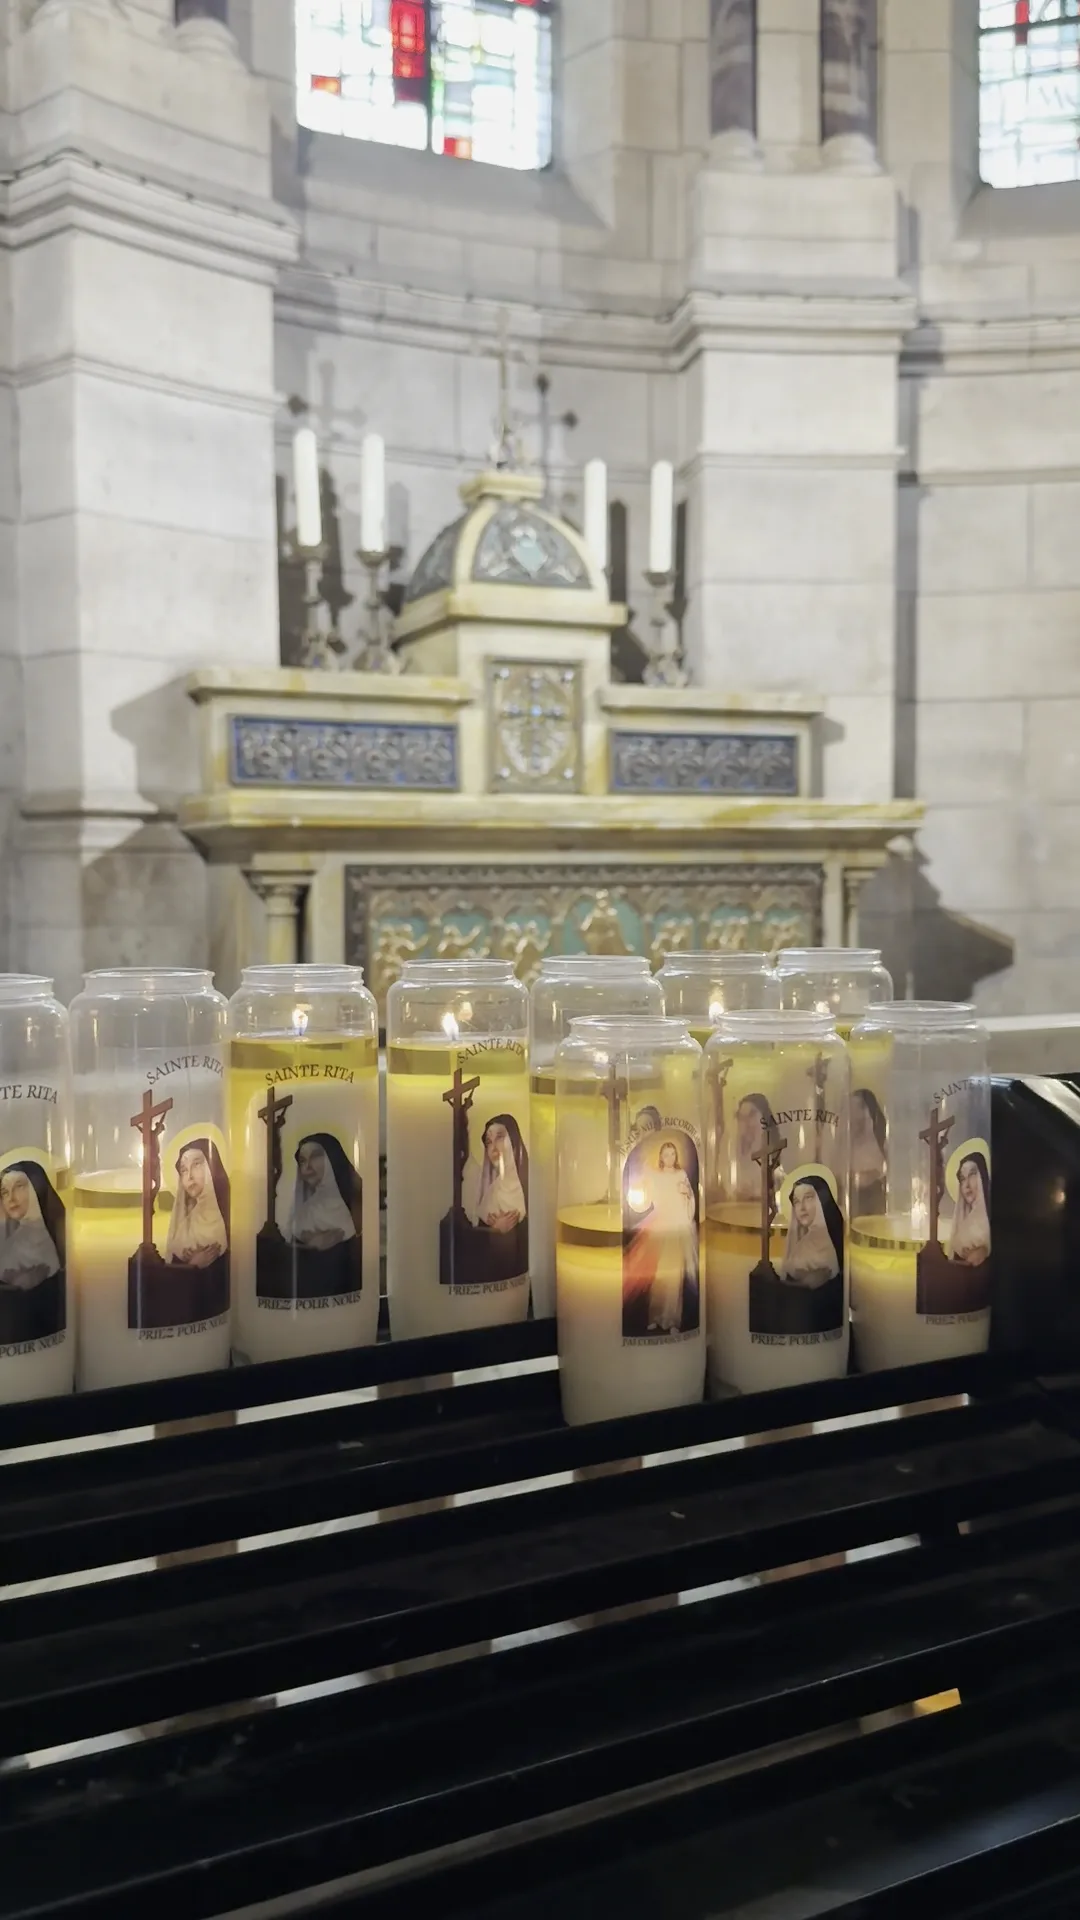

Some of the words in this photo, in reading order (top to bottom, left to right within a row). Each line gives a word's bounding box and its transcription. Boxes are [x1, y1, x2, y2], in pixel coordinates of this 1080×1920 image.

[457, 1038, 503, 1064] SAINTE
[146, 1055, 200, 1085] SAINTE
[203, 1055, 224, 1078] RITA
[265, 1063, 319, 1086] SAINTE
[324, 1064, 354, 1083] RITA
[27, 1084, 57, 1104] RITA
[760, 1109, 811, 1130] SAINTE
[815, 1109, 839, 1127] RITA
[258, 1298, 291, 1310] PRIEZ
[296, 1299, 329, 1310] POUR
[139, 1328, 174, 1341] PRIEZ
[177, 1321, 207, 1337] POUR
[751, 1333, 786, 1346] PRIEZ
[789, 1334, 820, 1346] POUR
